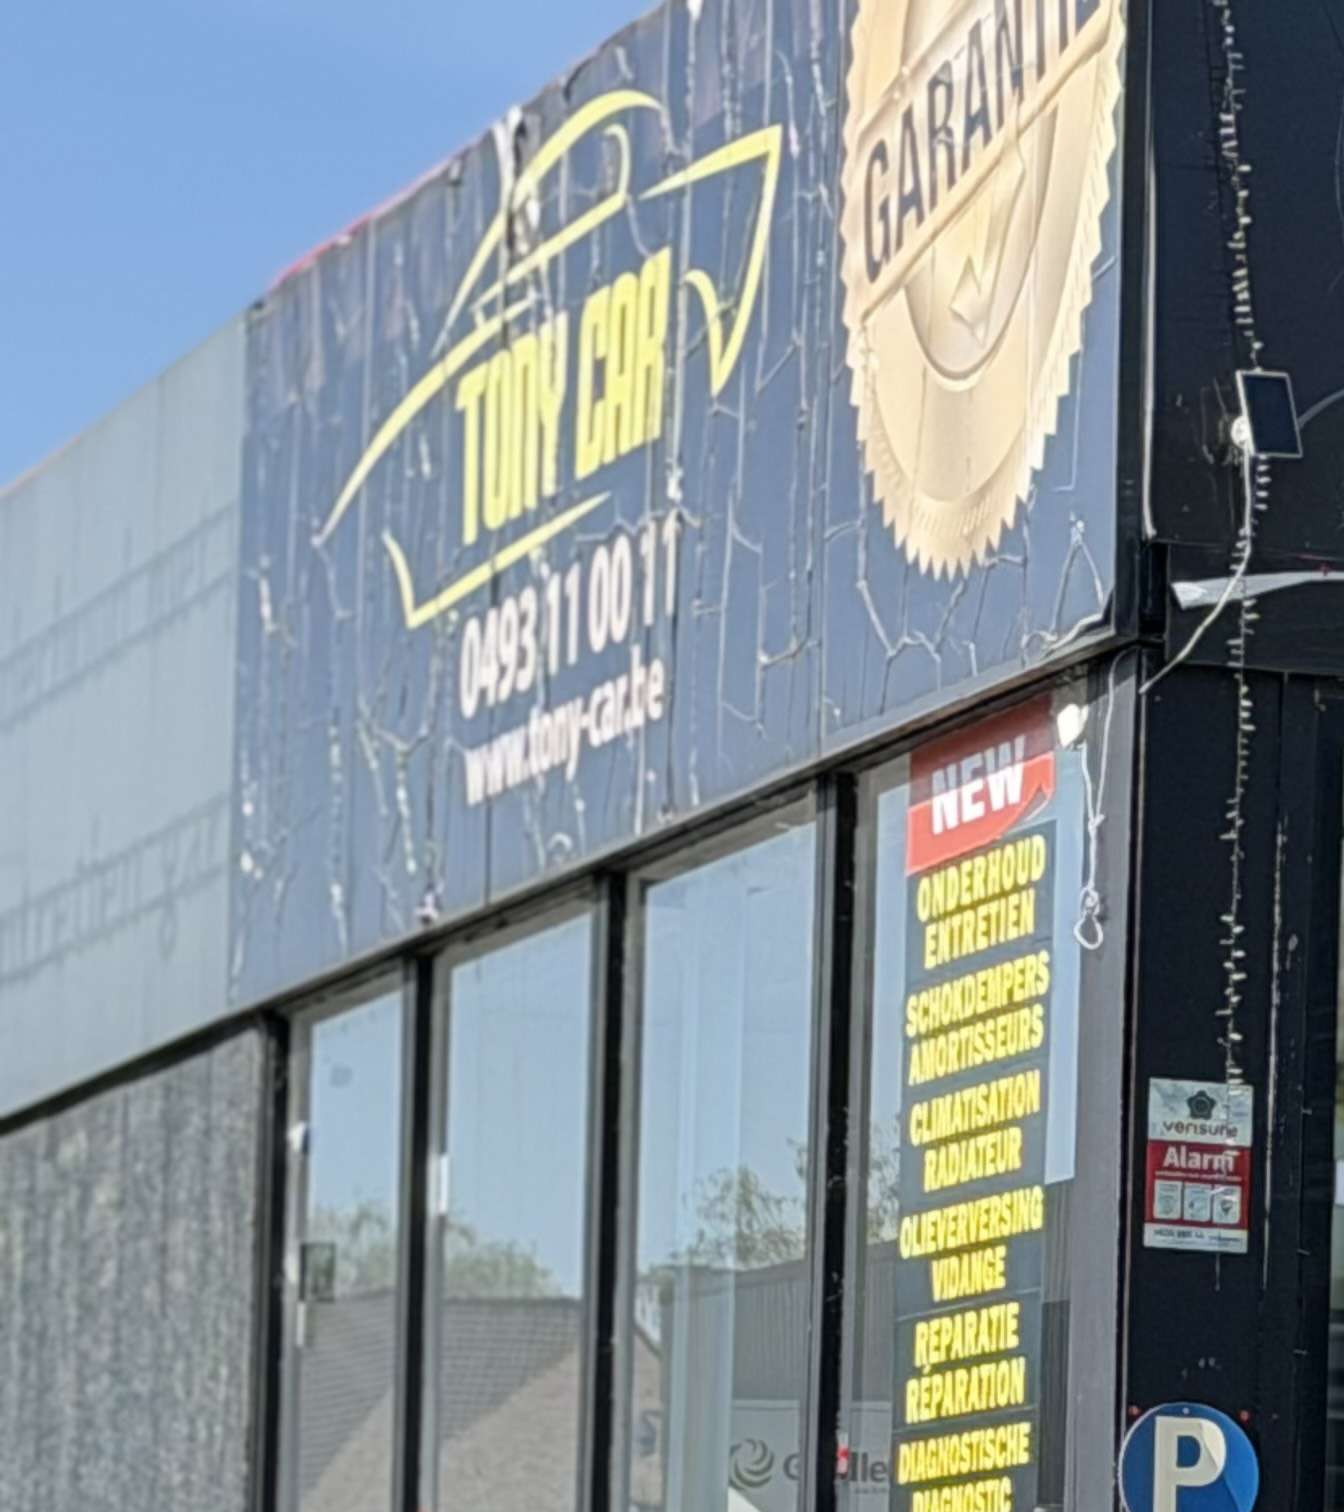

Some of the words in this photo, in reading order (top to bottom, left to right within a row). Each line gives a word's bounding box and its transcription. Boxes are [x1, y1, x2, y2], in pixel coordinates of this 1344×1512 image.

[455, 311, 569, 546] TONY
[574, 245, 672, 480] CAR
[459, 616, 538, 719] 0493
[546, 561, 581, 676] 11
[587, 533, 632, 653] 00
[640, 506, 680, 626] 11
[464, 643, 665, 806] www.tony-car.be
[931, 735, 1026, 836] NEW
[917, 834, 1047, 924] ONDERHOUD
[923, 887, 1036, 970] ENTRETIEN
[905, 949, 1050, 1038] SCHOKDEMPERS
[908, 1003, 1044, 1087] AMORTISSEURS
[909, 1068, 1041, 1147] CLIMATISATION
[1162, 1120, 1239, 1139] verisure
[923, 1126, 1023, 1193] RADIATEUR
[1162, 1145, 1237, 1173] Alarm
[899, 1184, 1044, 1260] OLIEVERVERSING
[930, 1244, 1007, 1303] VIDANGE
[914, 1301, 1020, 1368] REPARATIE
[905, 1355, 1026, 1425] RÉPARATION
[897, 1420, 1032, 1485] DIAGNOSTISCHE
